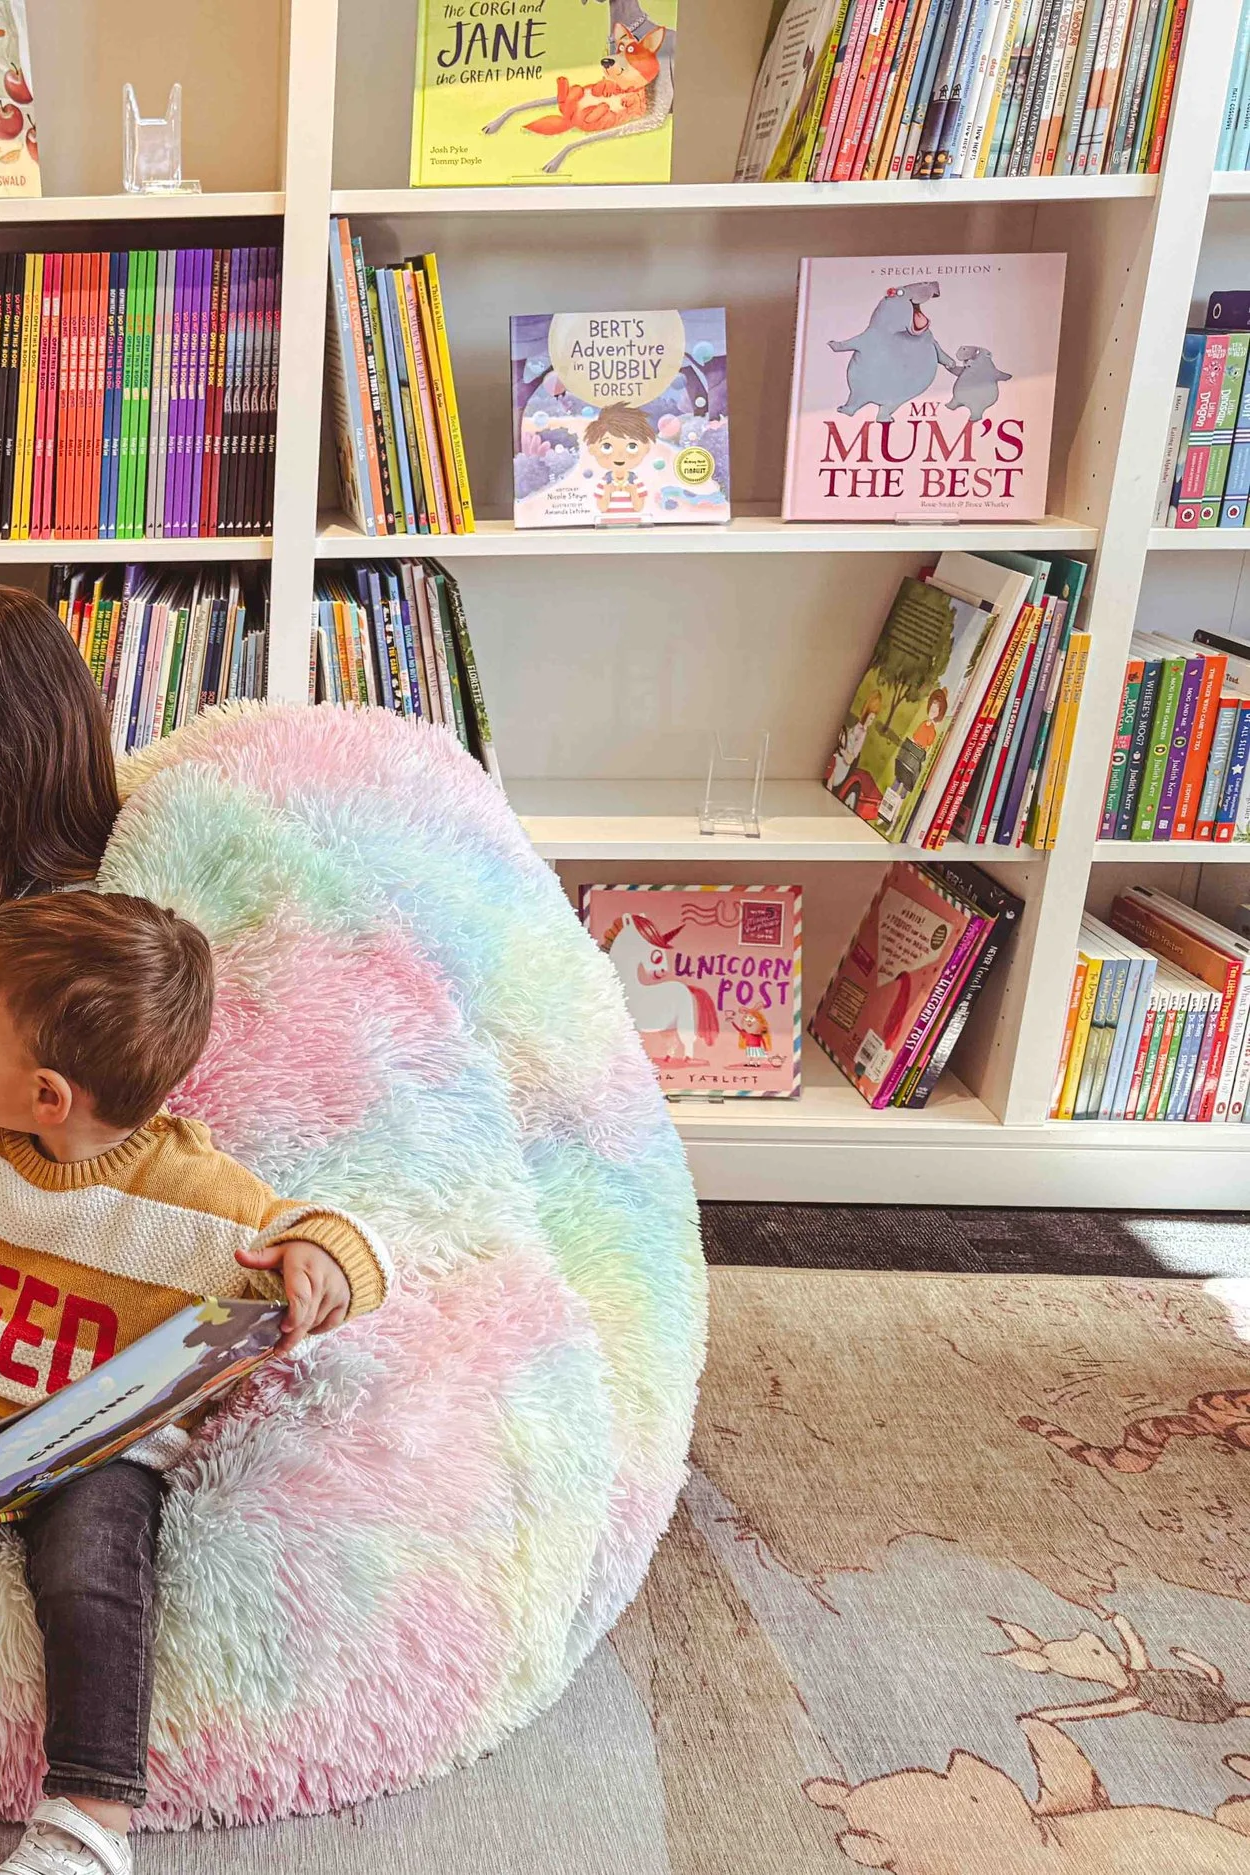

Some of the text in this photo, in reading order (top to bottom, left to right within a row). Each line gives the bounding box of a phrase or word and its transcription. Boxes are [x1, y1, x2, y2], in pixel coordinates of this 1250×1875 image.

[444, 0, 543, 19] the CORGI and
[437, 18, 547, 68] JANE
[436, 71, 456, 86] the
[460, 68, 500, 84] GREAT
[989, 58, 997, 77] dad
[1020, 60, 1040, 134] ANNA PIGNATARO
[1030, 57, 1049, 132] ANNA PIGNATARO
[430, 146, 468, 154] Josh Pyke
[430, 157, 482, 166] Tommy Doyle
[880, 264, 991, 276] SPECIAL EDITION
[589, 319, 645, 338] BERT'S
[571, 340, 665, 358] Adventure
[574, 359, 662, 381] in BUBBLY
[372, 395, 380, 411] FISH
[593, 382, 643, 397] FOREST
[910, 402, 941, 417] MY
[1195, 392, 1211, 427] Dragon
[820, 418, 1024, 463] MUM'S
[547, 492, 568, 500] Nicole
[818, 467, 1024, 498] THE BEST
[467, 665, 482, 704] FLORETTE
[1125, 699, 1137, 724] MOG
[1136, 680, 1155, 746] WHERE'S MOG?
[1214, 711, 1234, 765] DREAMERS
[1106, 768, 1120, 810] Judith Kerr
[1125, 769, 1138, 810] Judith Kerr
[1149, 759, 1162, 797] Judith Kerr
[1167, 759, 1180, 798] Judith Kerr
[674, 952, 792, 980] UNICORN
[983, 945, 998, 966] NEVER
[716, 978, 790, 1011] POST
[1219, 965, 1239, 1033] Ten Little Tractors
[905, 978, 952, 1051] UNICORN POST
